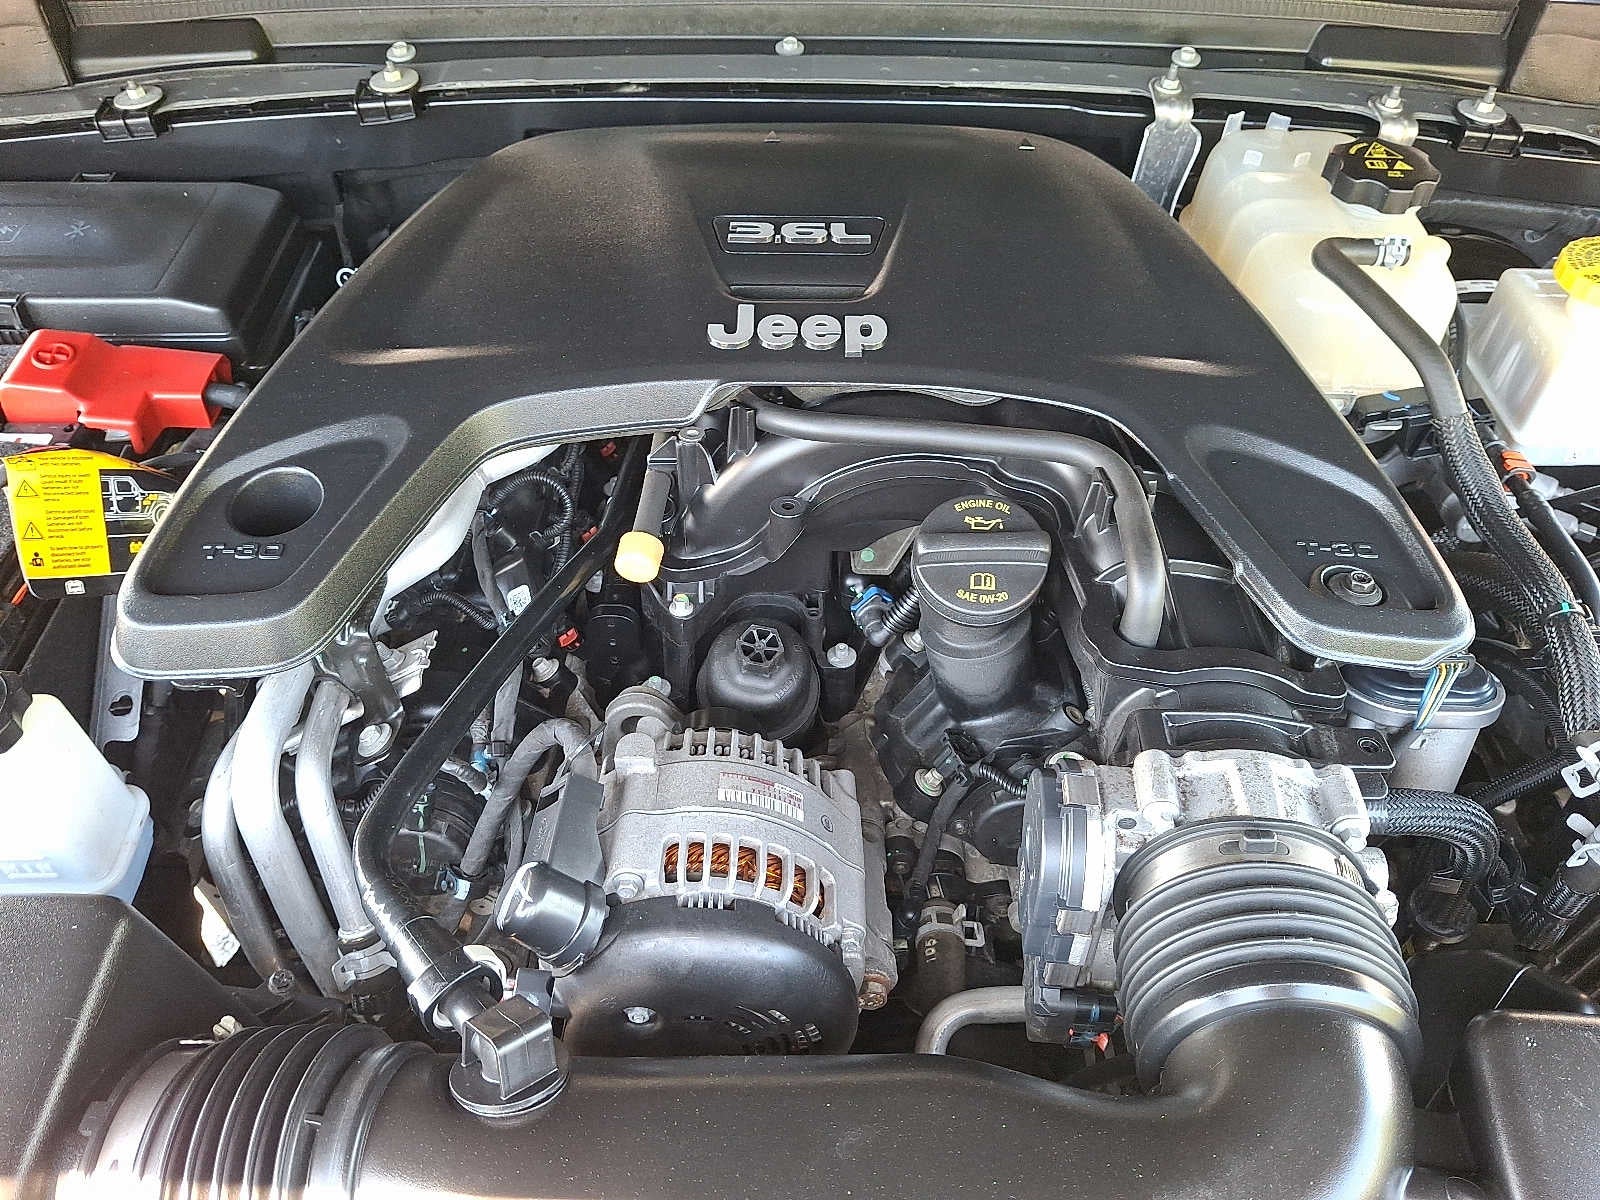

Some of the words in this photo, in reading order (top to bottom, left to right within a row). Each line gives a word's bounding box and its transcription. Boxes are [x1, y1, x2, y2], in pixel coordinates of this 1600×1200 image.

[727, 221, 872, 244] 3.6L
[707, 303, 888, 357] Jeep
[953, 499, 994, 513] ENGINE
[995, 501, 1011, 515] OIL
[202, 542, 285, 560] T-30
[956, 588, 977, 603] SAE
[979, 590, 1009, 604] 0W-20
